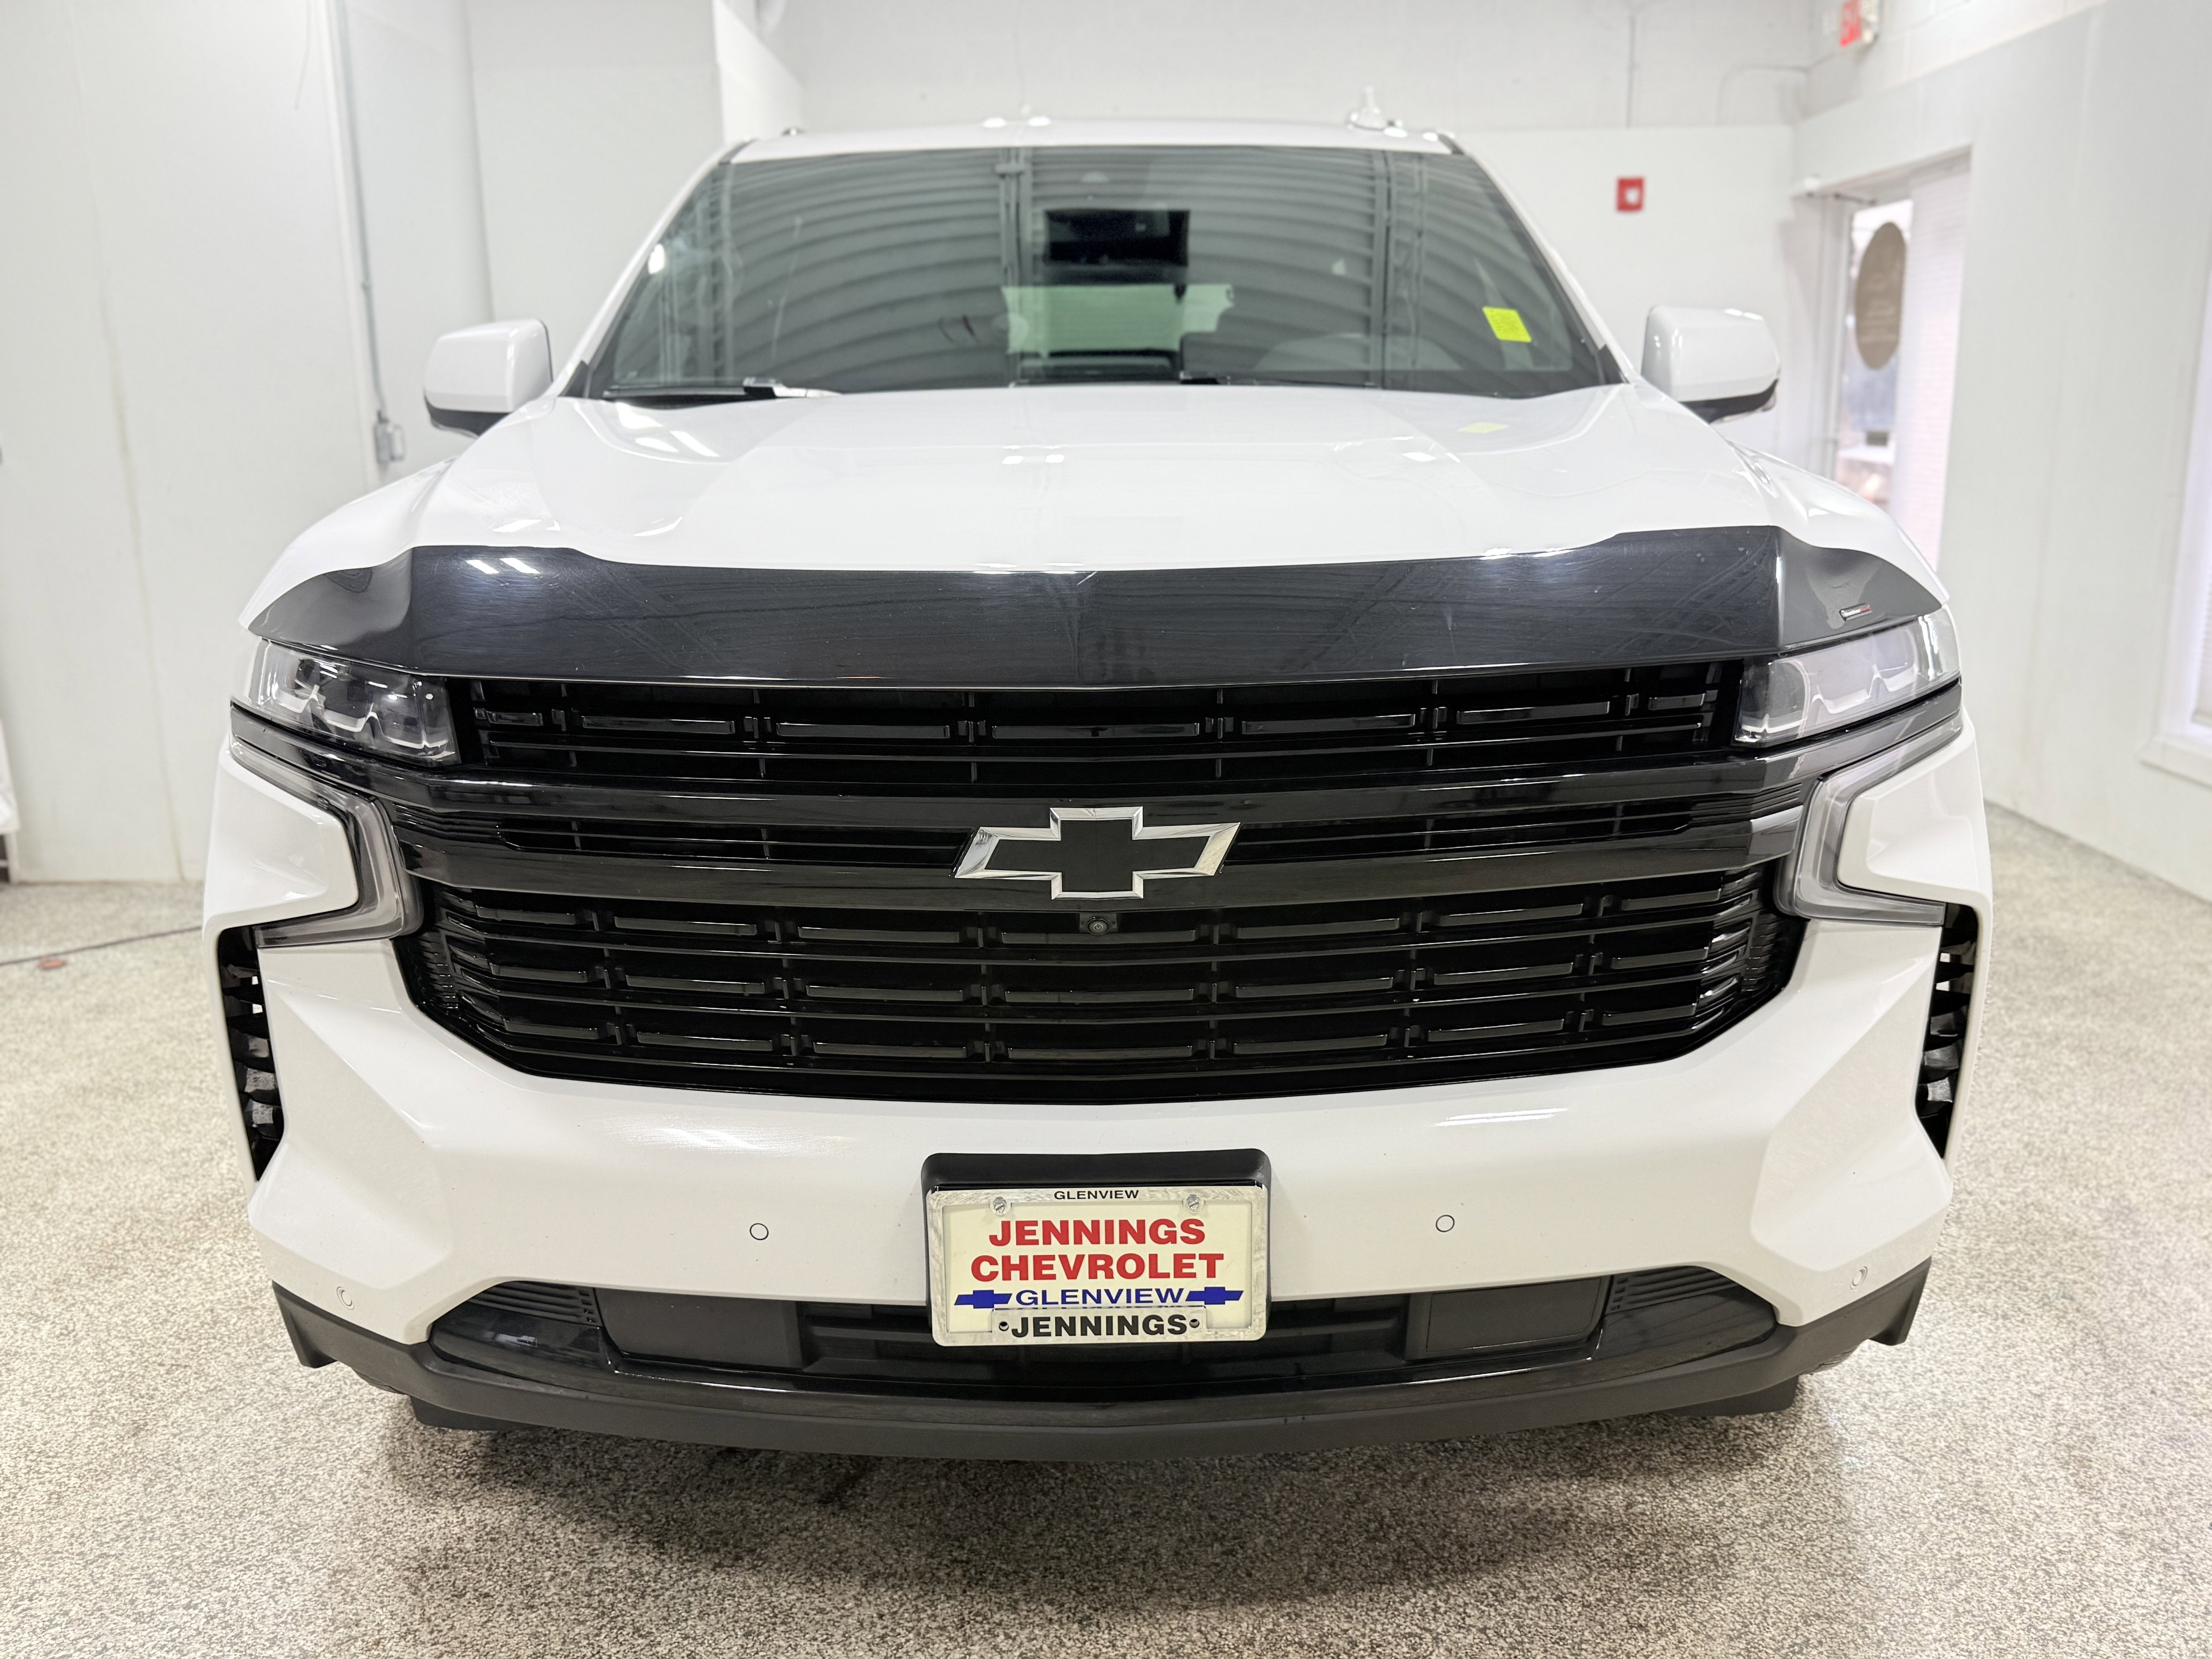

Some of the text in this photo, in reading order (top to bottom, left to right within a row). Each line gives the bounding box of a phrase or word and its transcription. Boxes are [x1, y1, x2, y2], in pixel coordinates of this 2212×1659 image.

[1054, 1190, 1139, 1200] GLENVIEW
[989, 1219, 1205, 1247] JENNINGS
[971, 1254, 1224, 1282] CHEVROLET
[1015, 1288, 1184, 1305] GLENVIEW
[1011, 1314, 1187, 1338] JENNINGS
